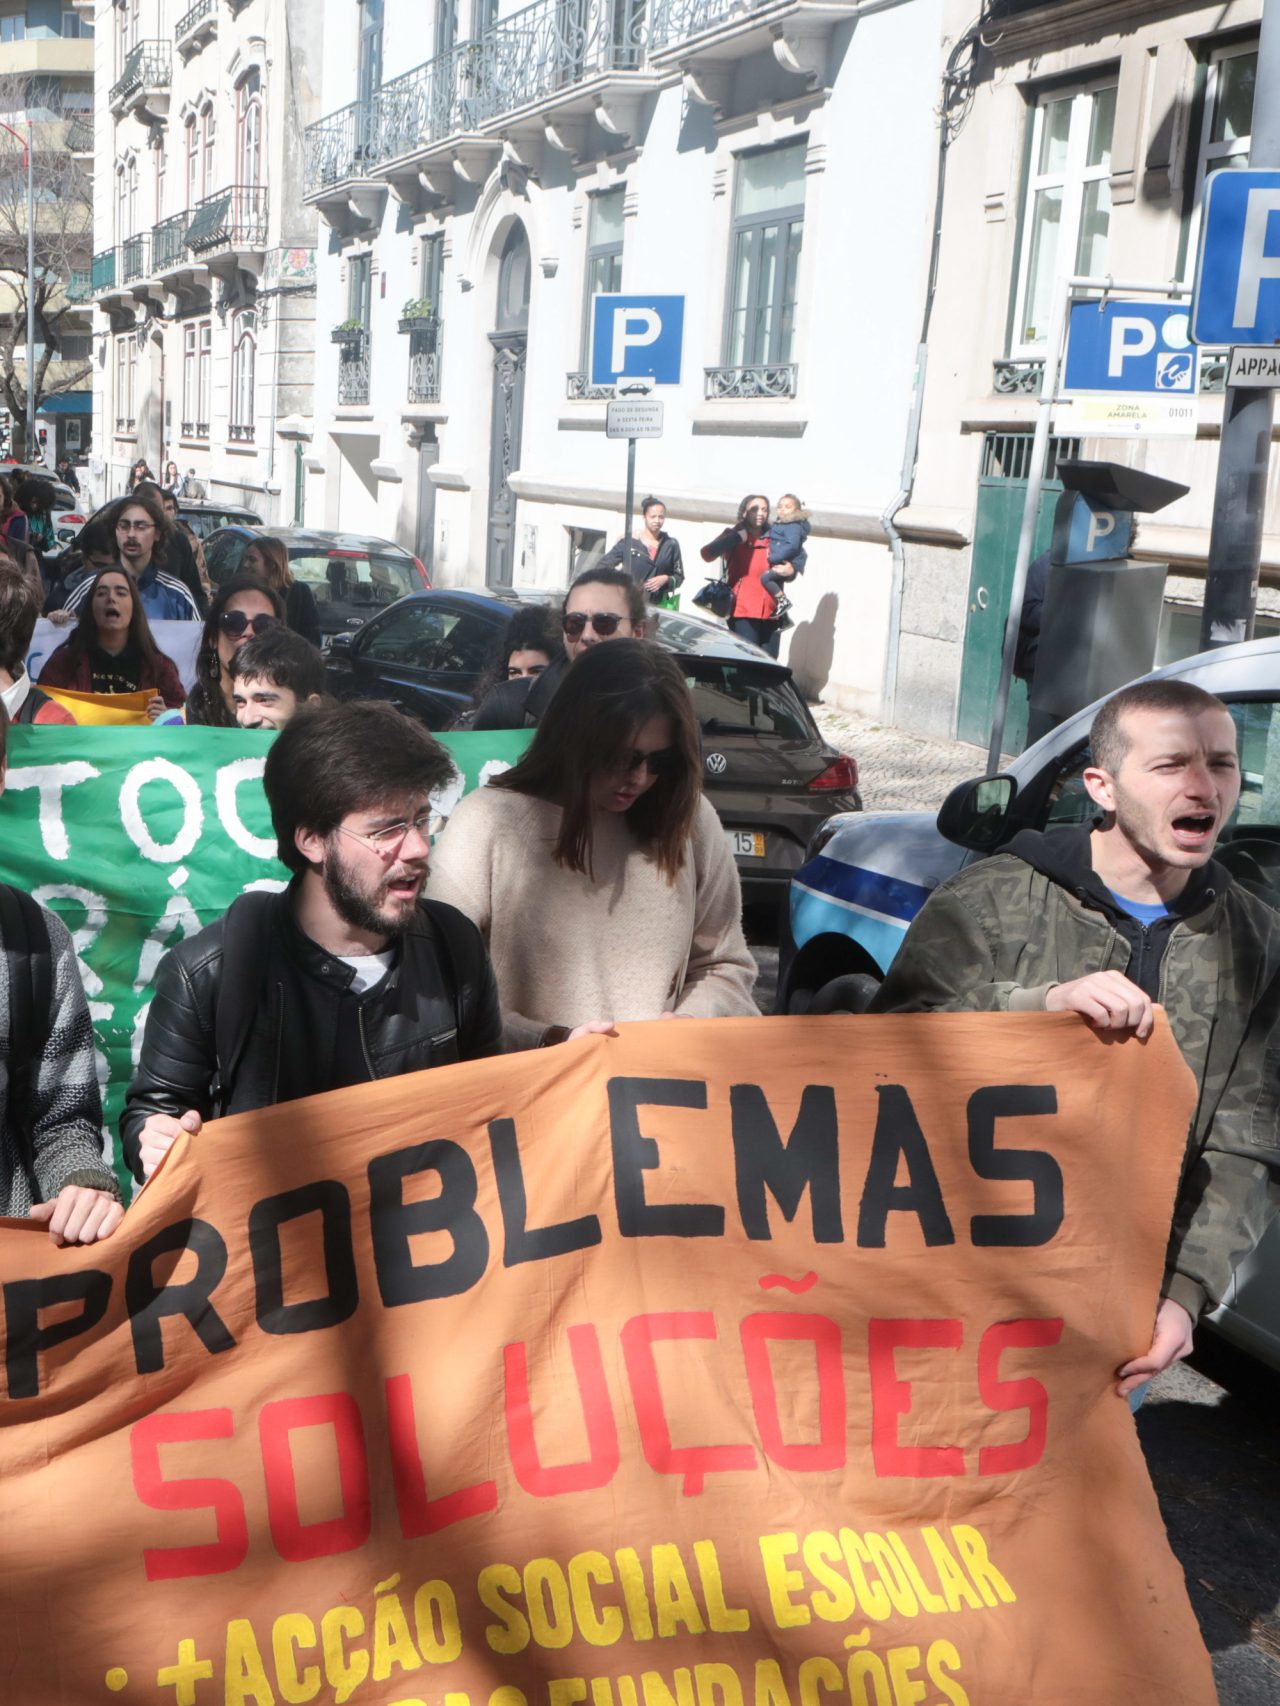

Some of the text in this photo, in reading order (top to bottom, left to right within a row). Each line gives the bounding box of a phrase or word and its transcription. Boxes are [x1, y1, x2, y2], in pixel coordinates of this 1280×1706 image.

[611, 308, 662, 373] P
[1108, 317, 1156, 377] P
[1236, 358, 1280, 376] APPA
[1107, 411, 1147, 419] AMARELA
[1169, 408, 1193, 417] 01011
[1086, 511, 1115, 552] P
[2, 1077, 1064, 1400] PROBLEMAS
[130, 1271, 1064, 1582] SOLUÇÕES
[477, 1539, 750, 1655] SOCIAL
[758, 1524, 1017, 1629] ESCOLAR
